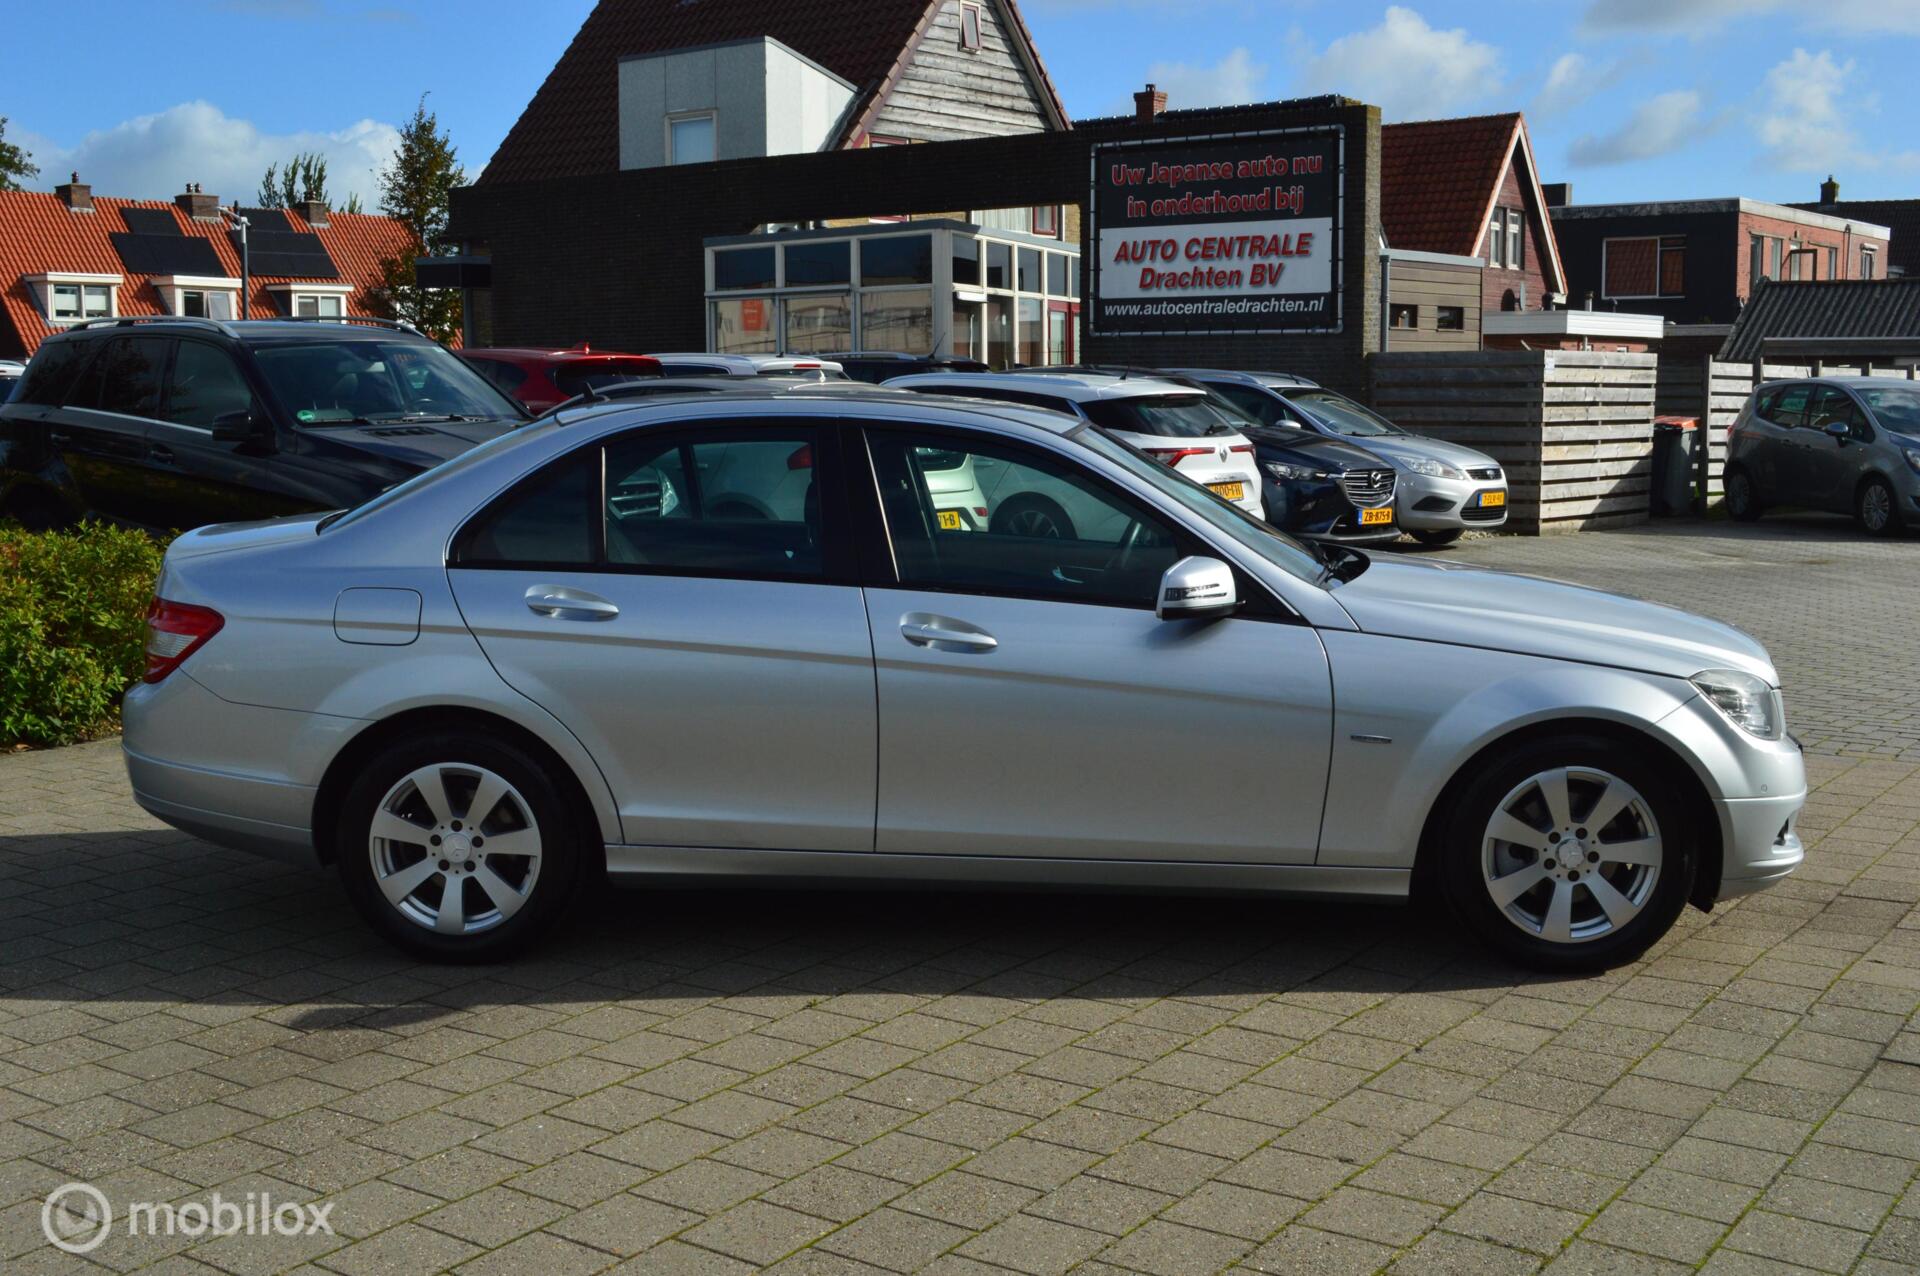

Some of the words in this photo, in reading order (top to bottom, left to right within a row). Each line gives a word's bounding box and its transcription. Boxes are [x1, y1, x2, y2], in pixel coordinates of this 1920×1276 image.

[1111, 164, 1145, 186] Uw
[1147, 160, 1233, 187] Japanse
[1237, 155, 1289, 178] auto
[1292, 155, 1323, 174] nu
[1127, 196, 1147, 217] in
[1151, 187, 1271, 216] onderhoud
[1275, 186, 1304, 215] bij
[1114, 238, 1178, 263] AUTO
[1184, 232, 1313, 260] CENTRALE
[1139, 266, 1242, 290] Drachten
[1249, 262, 1284, 286] BV
[1104, 296, 1325, 316] www.autocentraledrachten.nl
